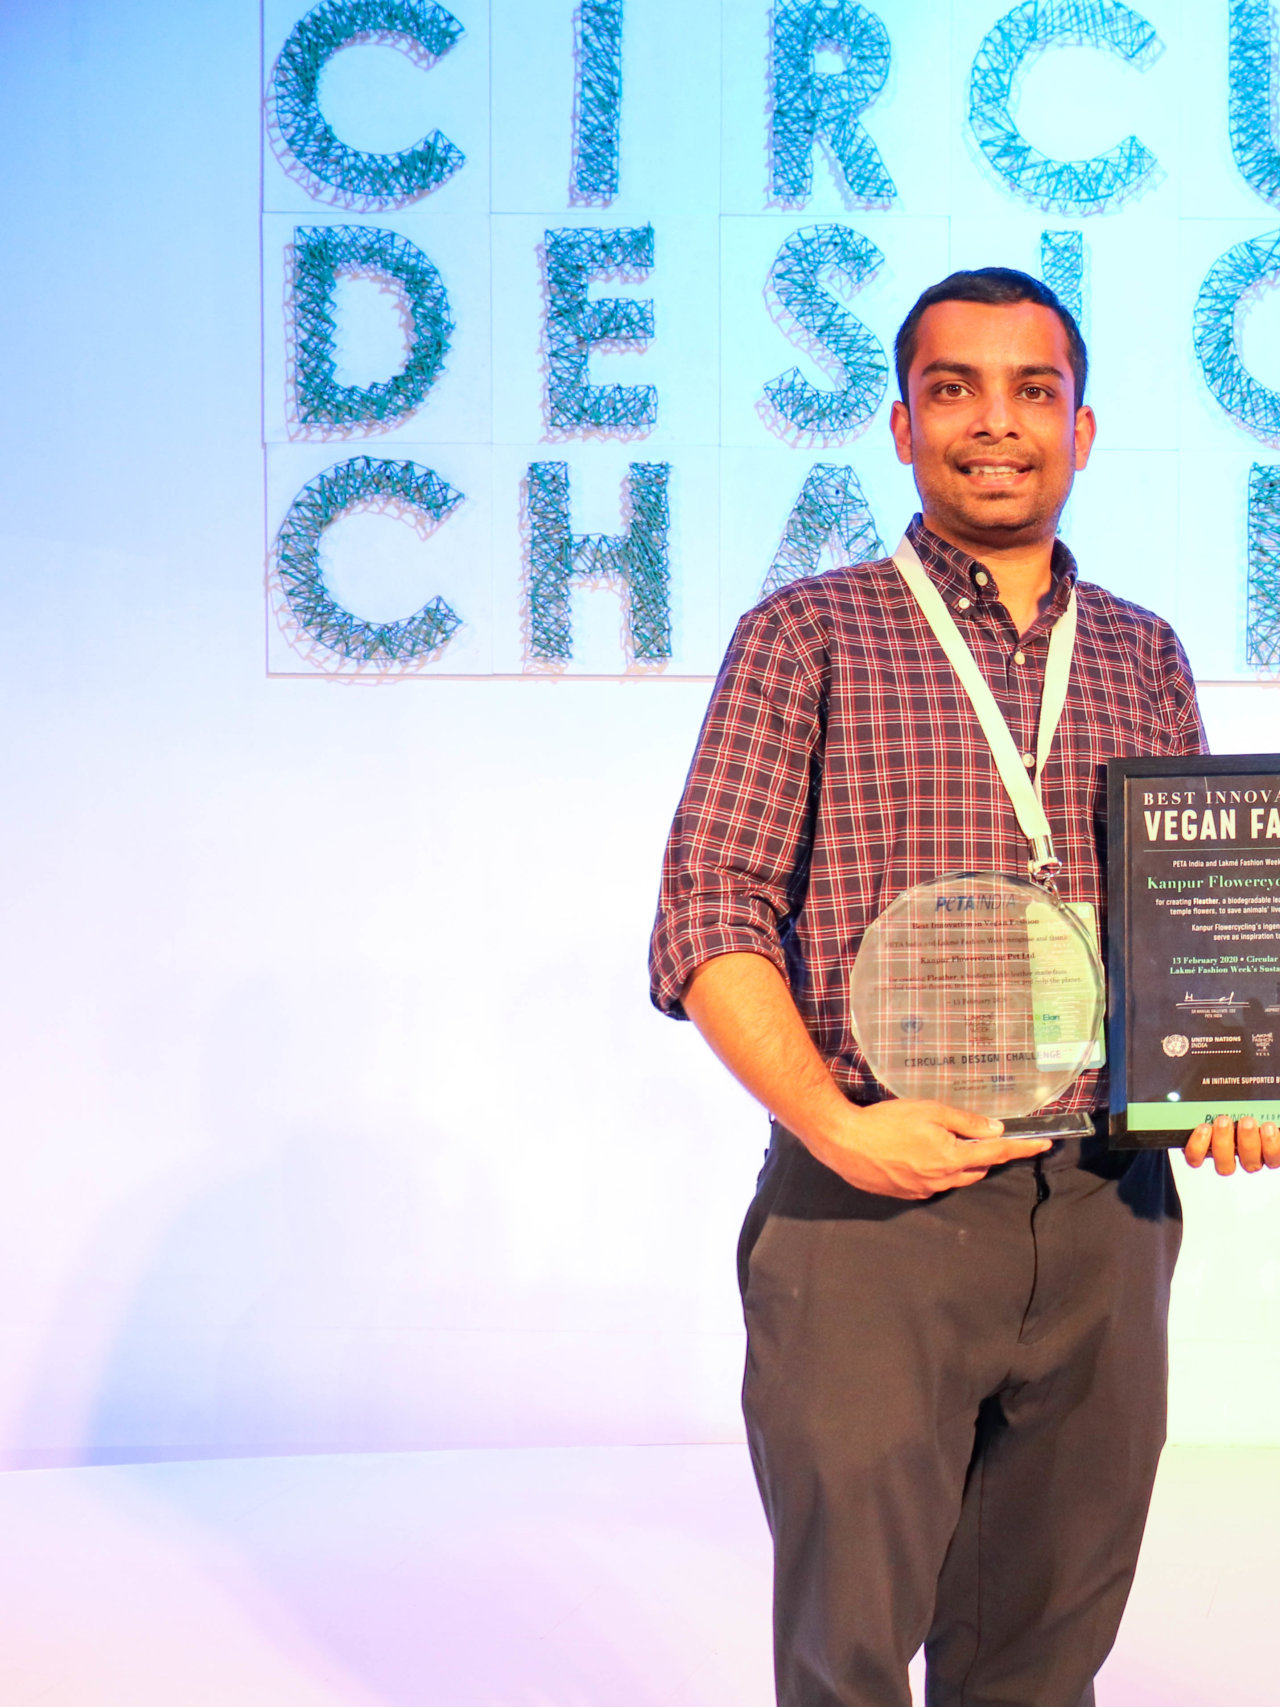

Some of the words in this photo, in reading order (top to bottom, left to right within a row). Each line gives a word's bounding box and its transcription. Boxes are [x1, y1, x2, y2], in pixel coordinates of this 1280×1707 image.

[1143, 792, 1196, 806] BEST
[1143, 808, 1237, 842] VEGAN
[1172, 860, 1187, 868] PETA
[1205, 859, 1217, 867] and
[1240, 858, 1264, 867] Fashion
[1265, 857, 1280, 866] Week
[1147, 876, 1204, 893] Kanpur
[1155, 898, 1165, 906] for
[1166, 898, 1192, 906] creating
[1228, 896, 1271, 905] biodegradable
[1170, 907, 1192, 916] temple
[1191, 924, 1213, 932] Kanpur
[1241, 933, 1274, 941] inspiration
[1183, 956, 1218, 966] February
[1220, 955, 1239, 964] 2020
[1246, 955, 1279, 963] Circular
[1170, 966, 1196, 975] Lakmé
[1198, 966, 1229, 974] Fashion
[1230, 965, 1258, 973] Week's
[904, 1056, 956, 1068] CIRCULAR
[961, 1053, 999, 1064] DESIGN
[1211, 1077, 1240, 1085] INITIATIVE
[1241, 1076, 1274, 1084] SUPPORTED
